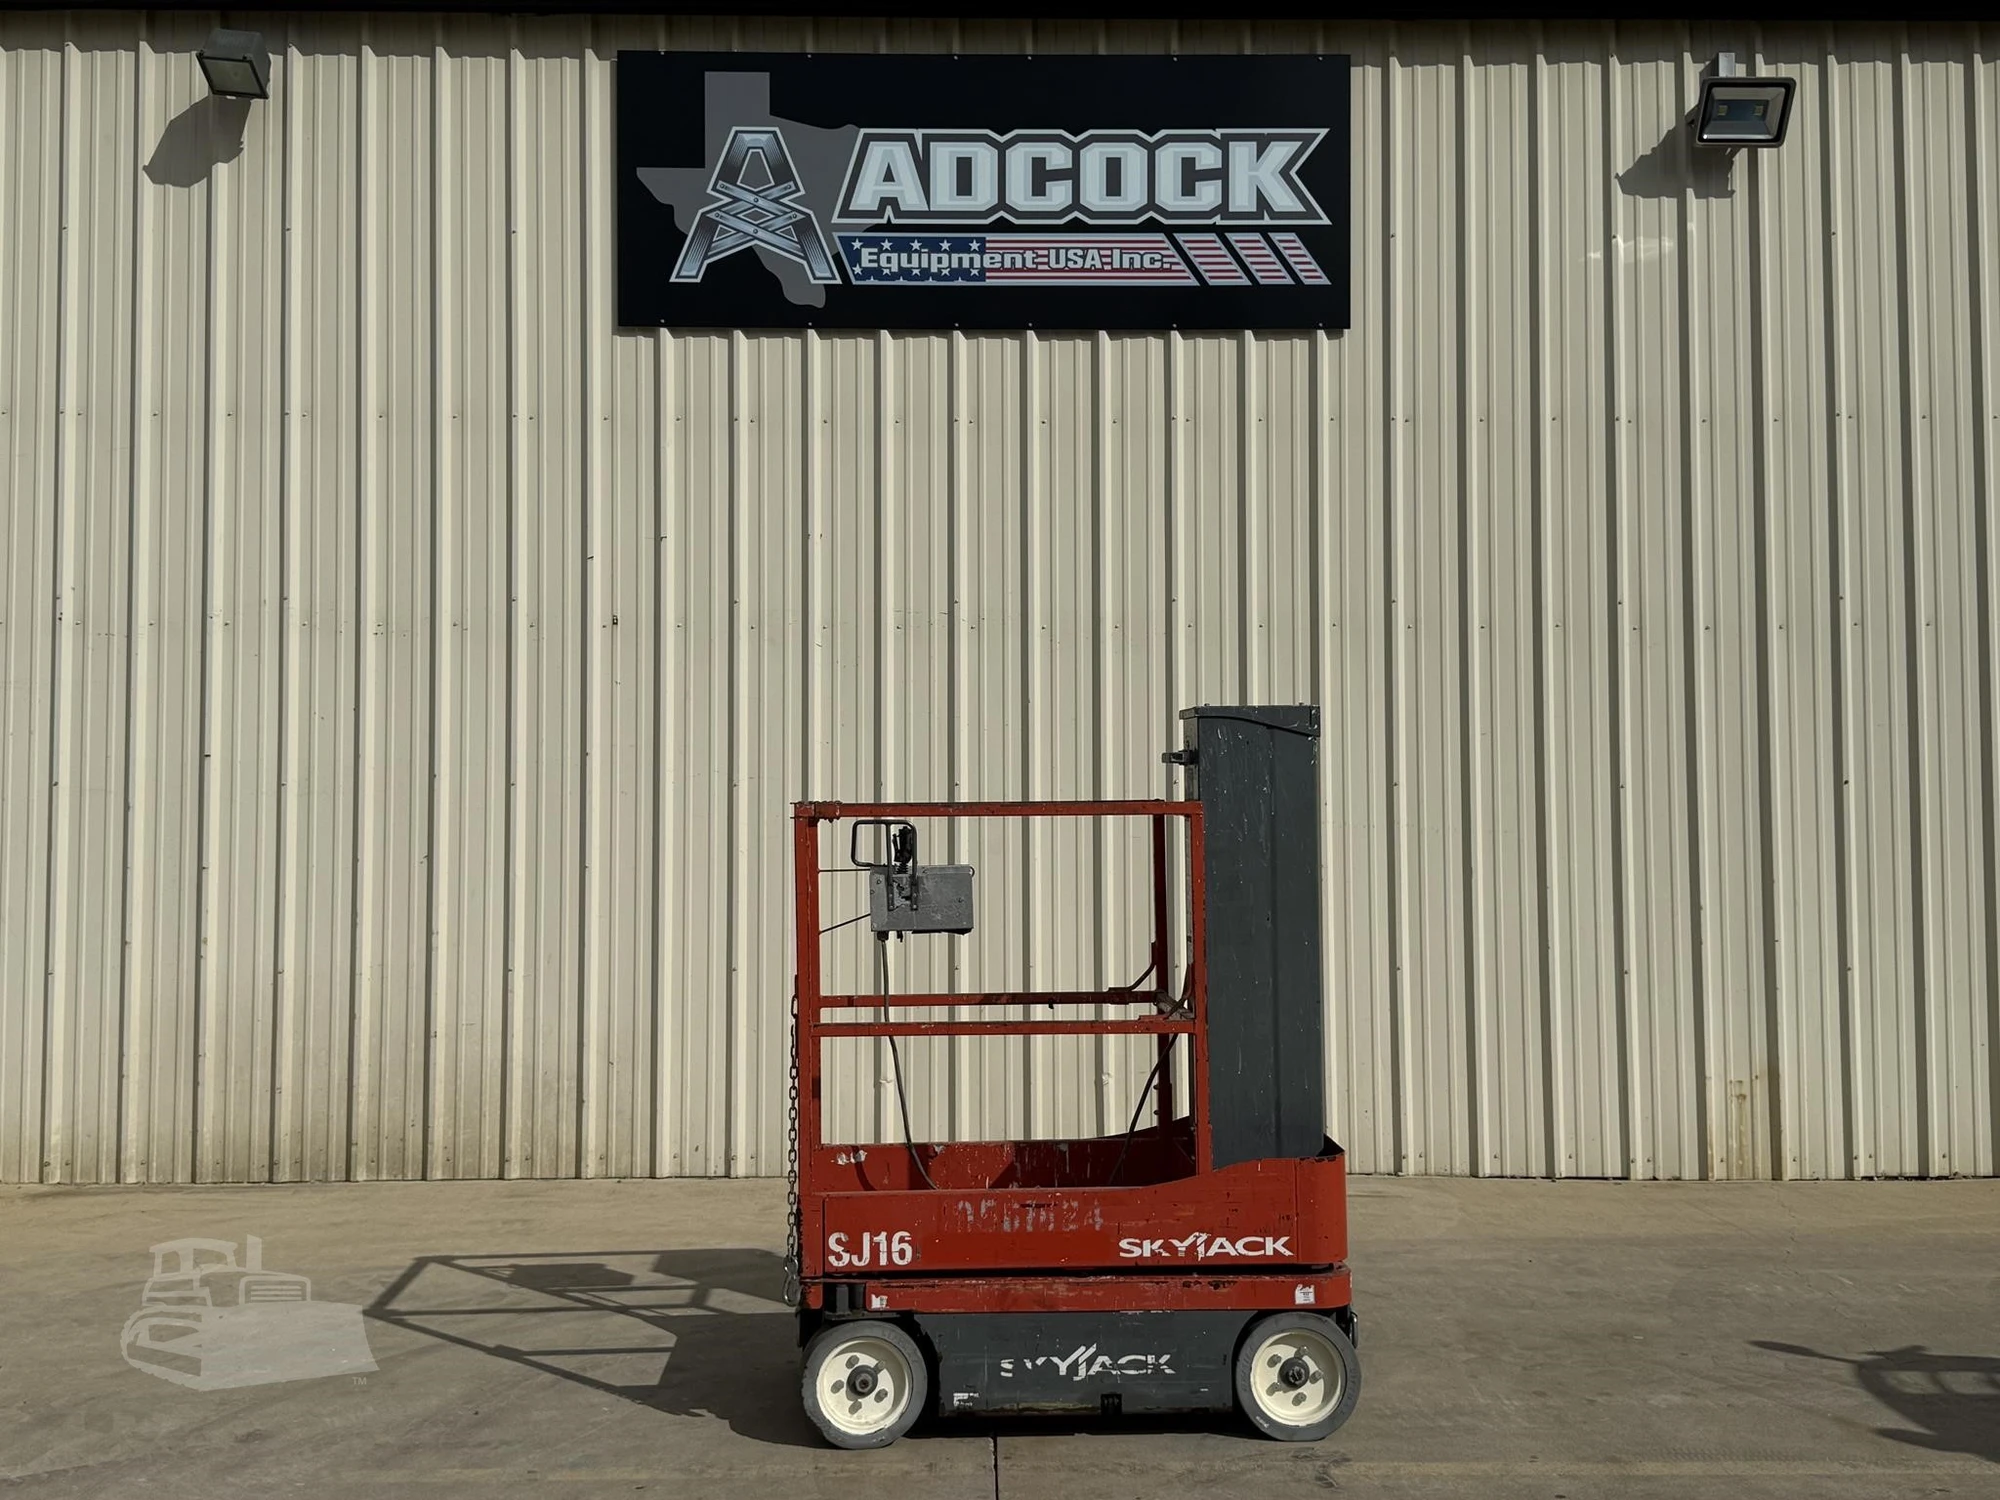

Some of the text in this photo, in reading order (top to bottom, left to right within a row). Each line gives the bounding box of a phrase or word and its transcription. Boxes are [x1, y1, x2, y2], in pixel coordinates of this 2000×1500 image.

[842, 134, 1315, 218] ADCOCK
[860, 247, 1173, 273] Equipment USA Inc.
[828, 1230, 913, 1267] SJ16
[1118, 1231, 1294, 1261] SKYJACK
